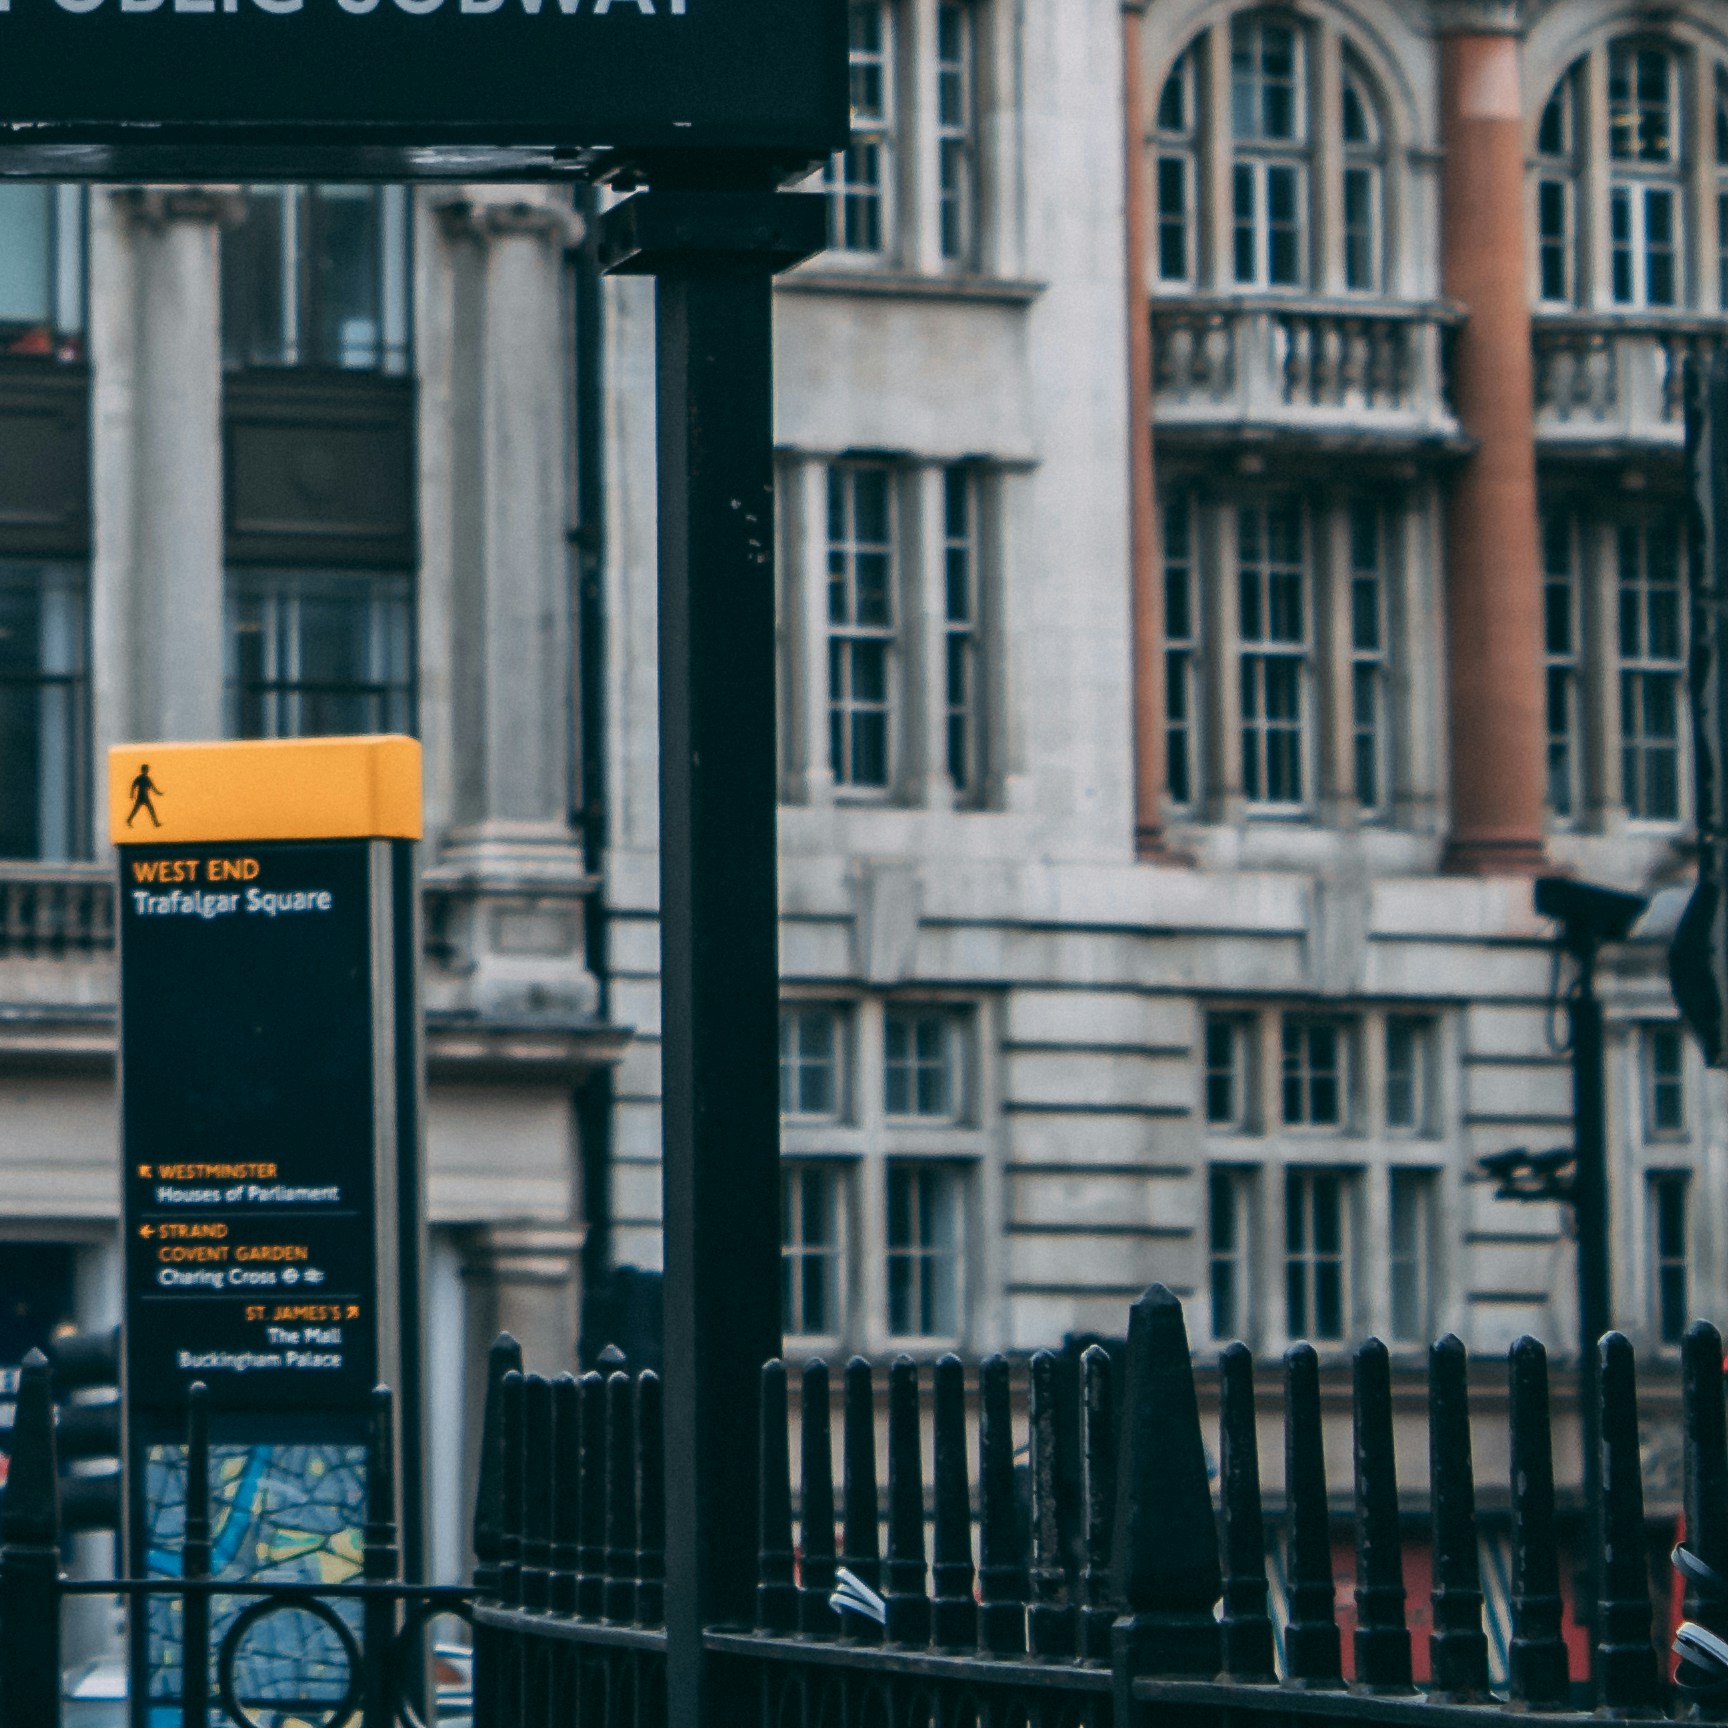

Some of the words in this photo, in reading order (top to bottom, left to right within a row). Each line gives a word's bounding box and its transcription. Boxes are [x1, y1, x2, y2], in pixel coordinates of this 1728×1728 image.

[132, 859, 200, 883] WEST
[207, 857, 261, 881] END
[133, 889, 240, 919] Trafalgar
[245, 887, 332, 917] Square
[158, 1162, 277, 1180] WESTMINSTER
[156, 1185, 222, 1203] Houses
[225, 1184, 246, 1203] of
[247, 1184, 341, 1202] Parliament
[158, 1223, 229, 1239] STRAND
[158, 1245, 230, 1262] COVENT
[234, 1245, 308, 1261] GARDEN
[157, 1268, 224, 1288] Charing
[227, 1268, 277, 1285] Cross
[266, 1327, 300, 1345] The
[304, 1327, 343, 1345] Mall
[178, 1350, 282, 1371] Buckingham
[285, 1350, 343, 1368] Palace
